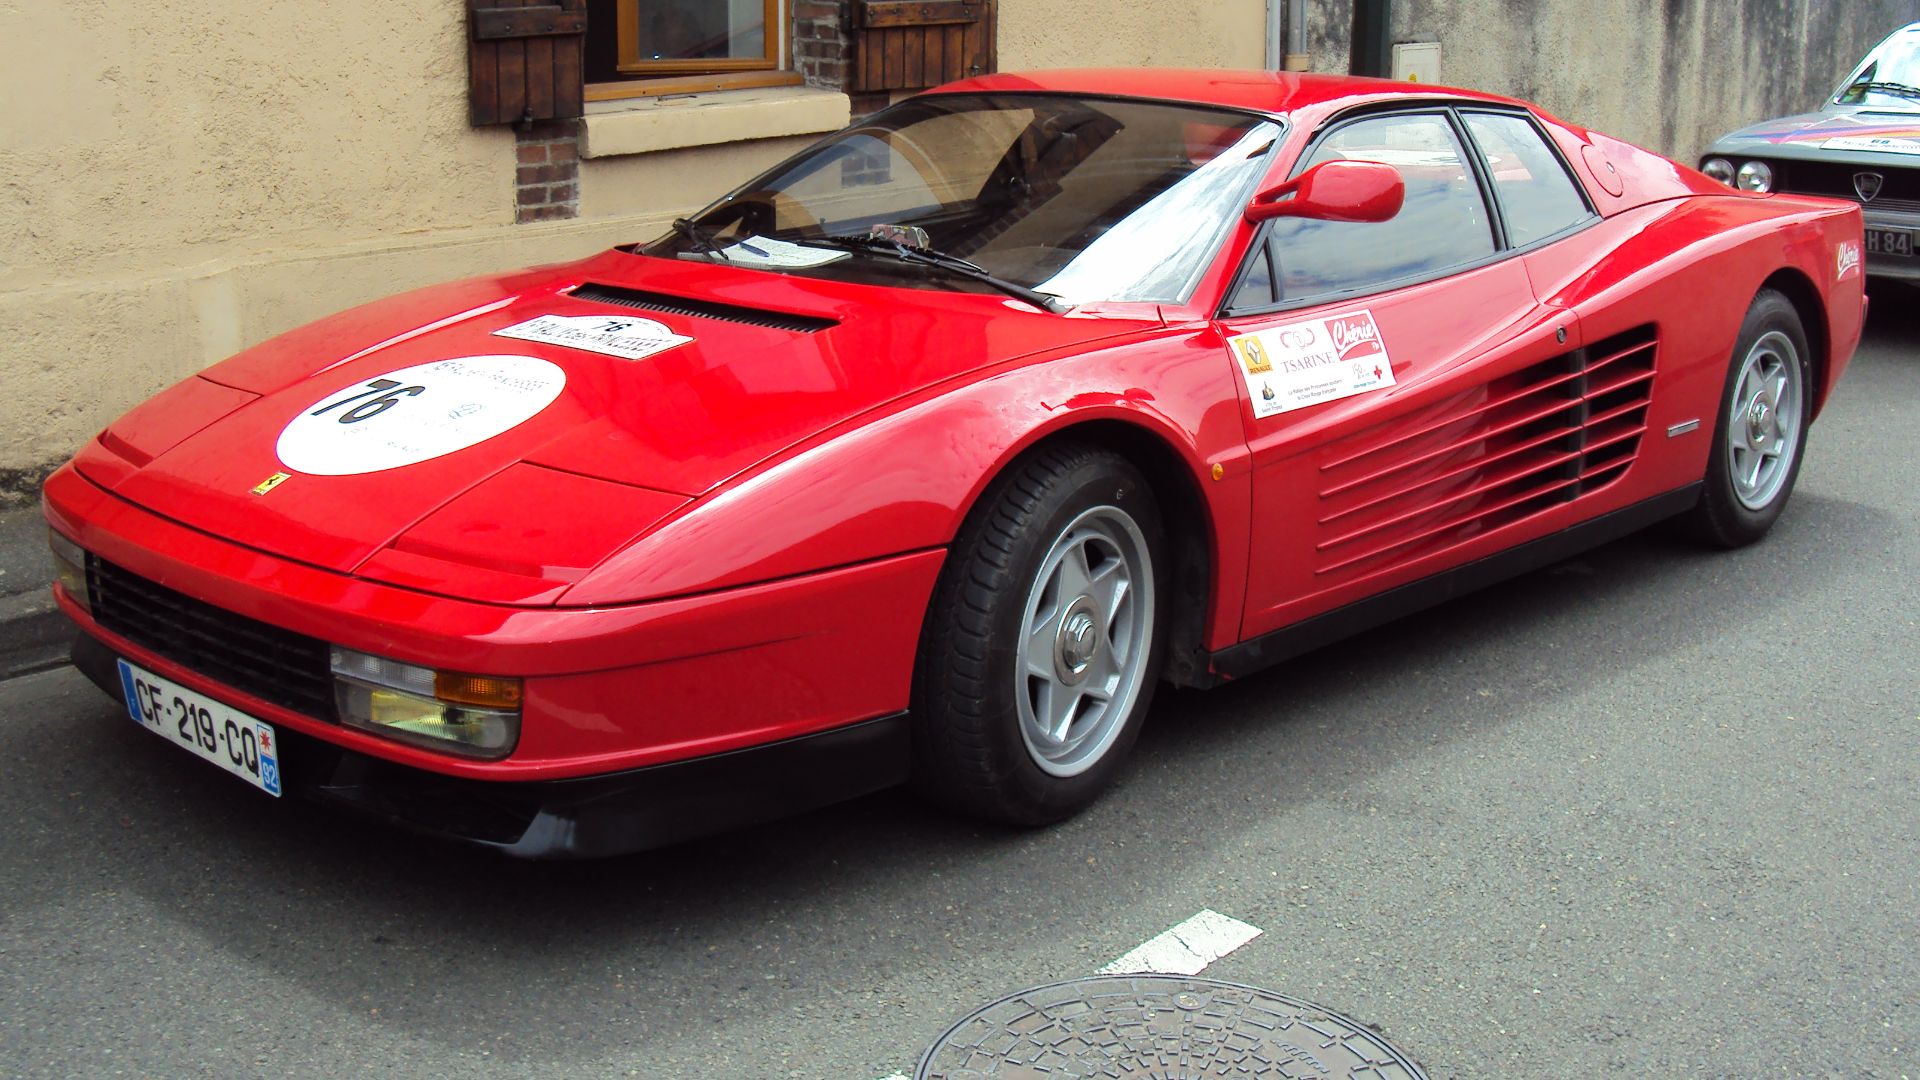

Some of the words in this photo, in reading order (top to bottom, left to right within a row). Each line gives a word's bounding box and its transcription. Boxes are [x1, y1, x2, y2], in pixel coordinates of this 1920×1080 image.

[1884, 233, 1908, 254] 84
[1333, 319, 1376, 351] Chérie
[1249, 364, 1273, 375] RENAULT
[1280, 351, 1336, 374] TSARINE
[310, 378, 426, 424] 76
[262, 763, 278, 787] 92
